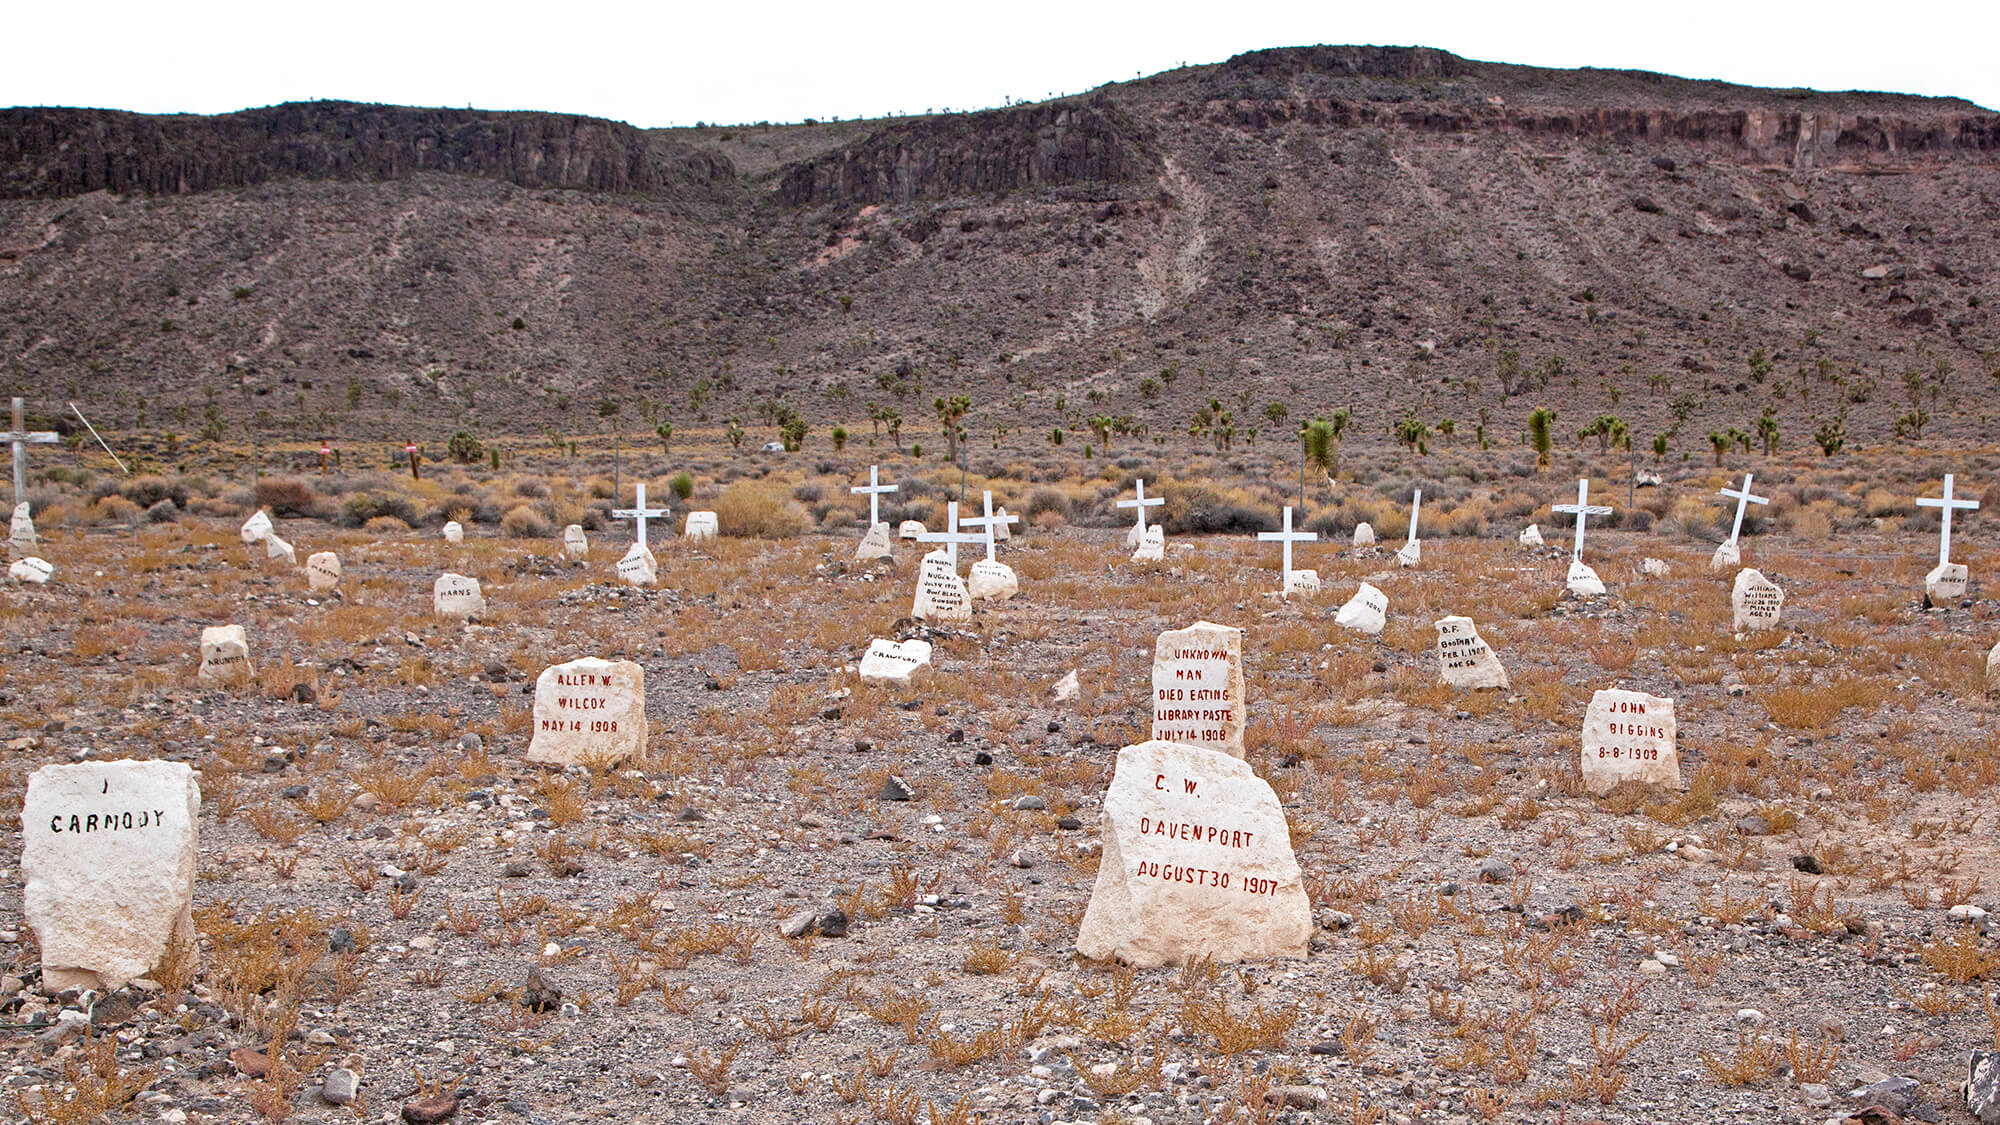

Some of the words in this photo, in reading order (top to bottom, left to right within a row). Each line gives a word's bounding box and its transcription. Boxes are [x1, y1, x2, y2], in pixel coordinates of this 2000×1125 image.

[1174, 649, 1228, 661] UNKNOWN
[557, 674, 595, 686] ALLEN
[1176, 669, 1203, 681] MAN
[1159, 689, 1184, 701] DIED
[1190, 689, 1230, 701] EATING
[558, 697, 606, 710] WILCOX
[1609, 701, 1646, 714] JOHN
[1157, 709, 1200, 721] LIBRARY
[1203, 709, 1233, 722] PASTE
[541, 720, 565, 732] MAY
[570, 720, 581, 732] 14
[590, 720, 618, 733] 1908
[1609, 722, 1664, 739] BIGGINS
[1156, 730, 1184, 741] JULY
[1186, 729, 1197, 740] 14
[1201, 729, 1226, 742] 1908
[50, 809, 165, 834] CARMODY
[1140, 817, 1254, 848] DAVENPORT
[1243, 877, 1278, 897] 1907
